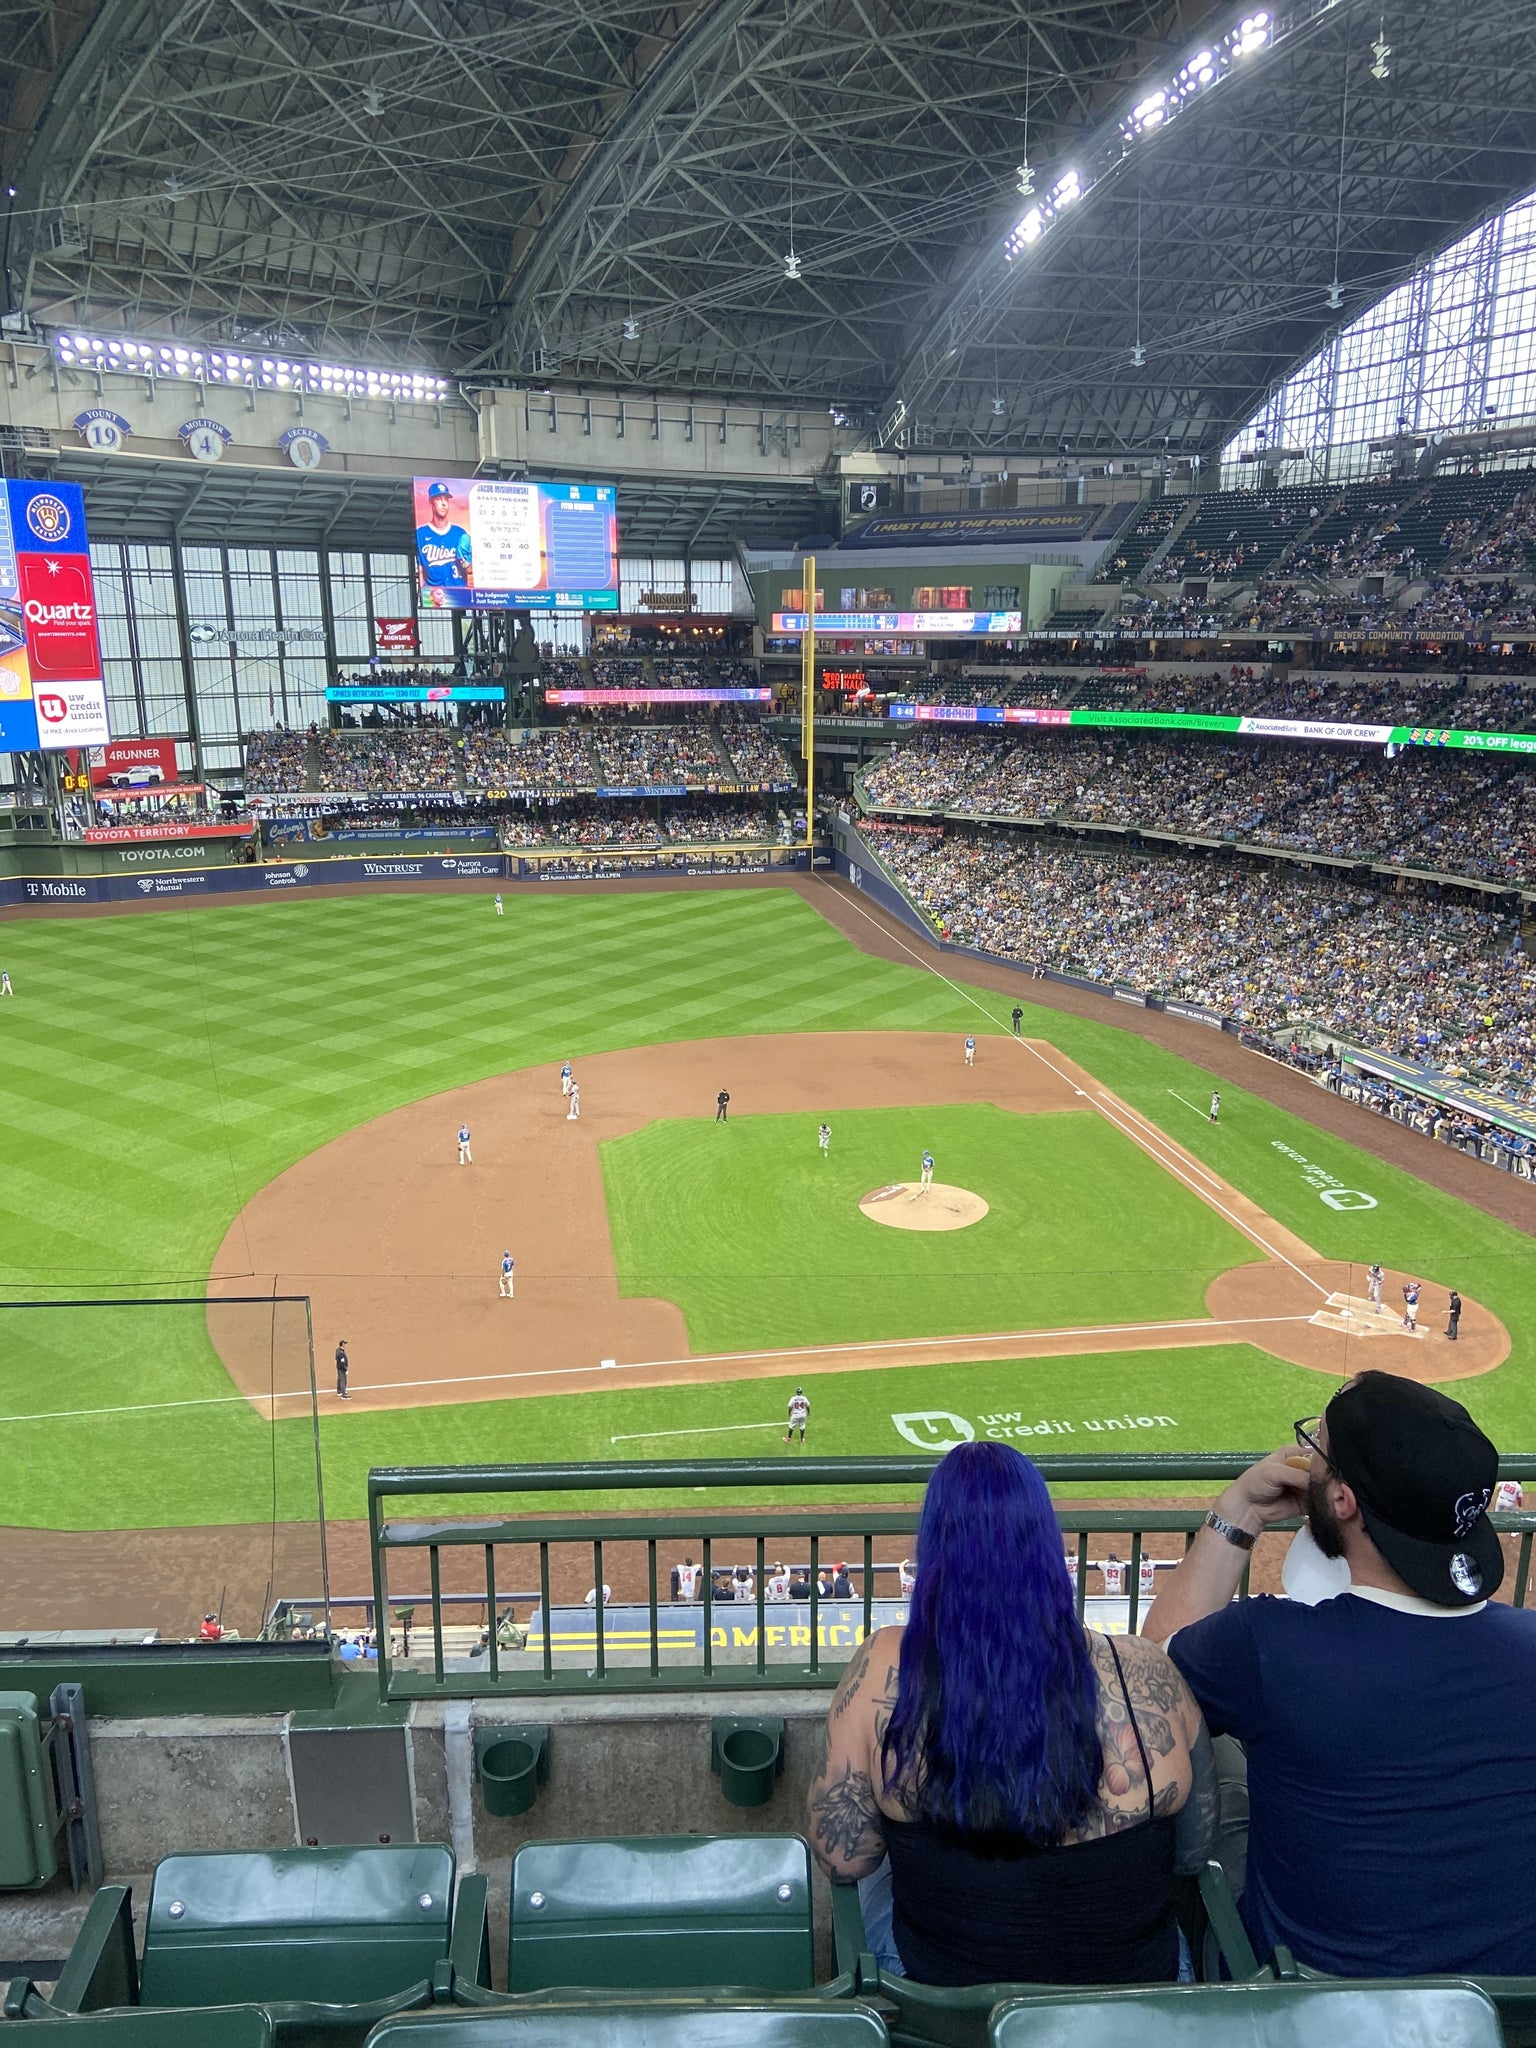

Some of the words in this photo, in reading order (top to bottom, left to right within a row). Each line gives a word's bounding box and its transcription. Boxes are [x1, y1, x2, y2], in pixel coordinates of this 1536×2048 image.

[86, 411, 118, 422] YOUNT
[185, 420, 224, 434] MOLITOR
[92, 426, 117, 446] 19
[287, 429, 319, 440] UECKER
[200, 436, 211, 454] 4
[477, 485, 493, 493] JACOB
[31, 498, 64, 514] MILWAUKEE
[880, 522, 922, 532] MUST
[922, 522, 938, 530] BE
[990, 518, 1036, 526] FRONT
[1039, 516, 1082, 525] ROW!
[422, 544, 456, 561] Wisc
[638, 589, 697, 605] Johnsonville
[25, 600, 92, 624] Quartz
[220, 628, 259, 641] Aurora
[264, 628, 298, 640] Health
[300, 629, 326, 640] Care
[1334, 632, 1366, 640] BREWERS
[1369, 632, 1412, 640] COMMUNITY
[1416, 632, 1465, 640] FOUNDATION
[70, 701, 101, 710] credit
[71, 712, 102, 720] union
[1089, 714, 1106, 723] Visit
[1109, 716, 1225, 729] AssociatedBank.com/Brewers
[1304, 726, 1324, 734] BANK
[1463, 735, 1483, 746] 20%
[1486, 737, 1508, 748] OFF
[109, 749, 160, 761] 4RUNNER
[65, 775, 88, 790] 0:16
[487, 790, 507, 799] 620
[509, 789, 540, 798] WTMJ
[718, 785, 744, 793] NICOLET
[88, 829, 130, 840] TOYOTA
[133, 826, 190, 838] TERRITORY
[119, 847, 205, 862] TOYOTA.COM
[364, 863, 422, 873] WINTRUST
[155, 876, 205, 885] Northwestern
[265, 871, 290, 880] Johnson
[269, 877, 296, 885] Controls
[27, 883, 38, 896] T
[41, 883, 87, 896] Mobile
[1271, 1141, 1308, 1163] union
[1300, 1176, 1326, 1188] uw
[1302, 1164, 1344, 1188] credit
[977, 1412, 1022, 1425] uw
[986, 1420, 1075, 1438] credit
[1082, 1414, 1179, 1432] union
[682, 1572, 692, 1582] 14
[1107, 1569, 1118, 1578] 83
[1141, 1569, 1152, 1577] 80
[776, 1584, 782, 1593] 8
